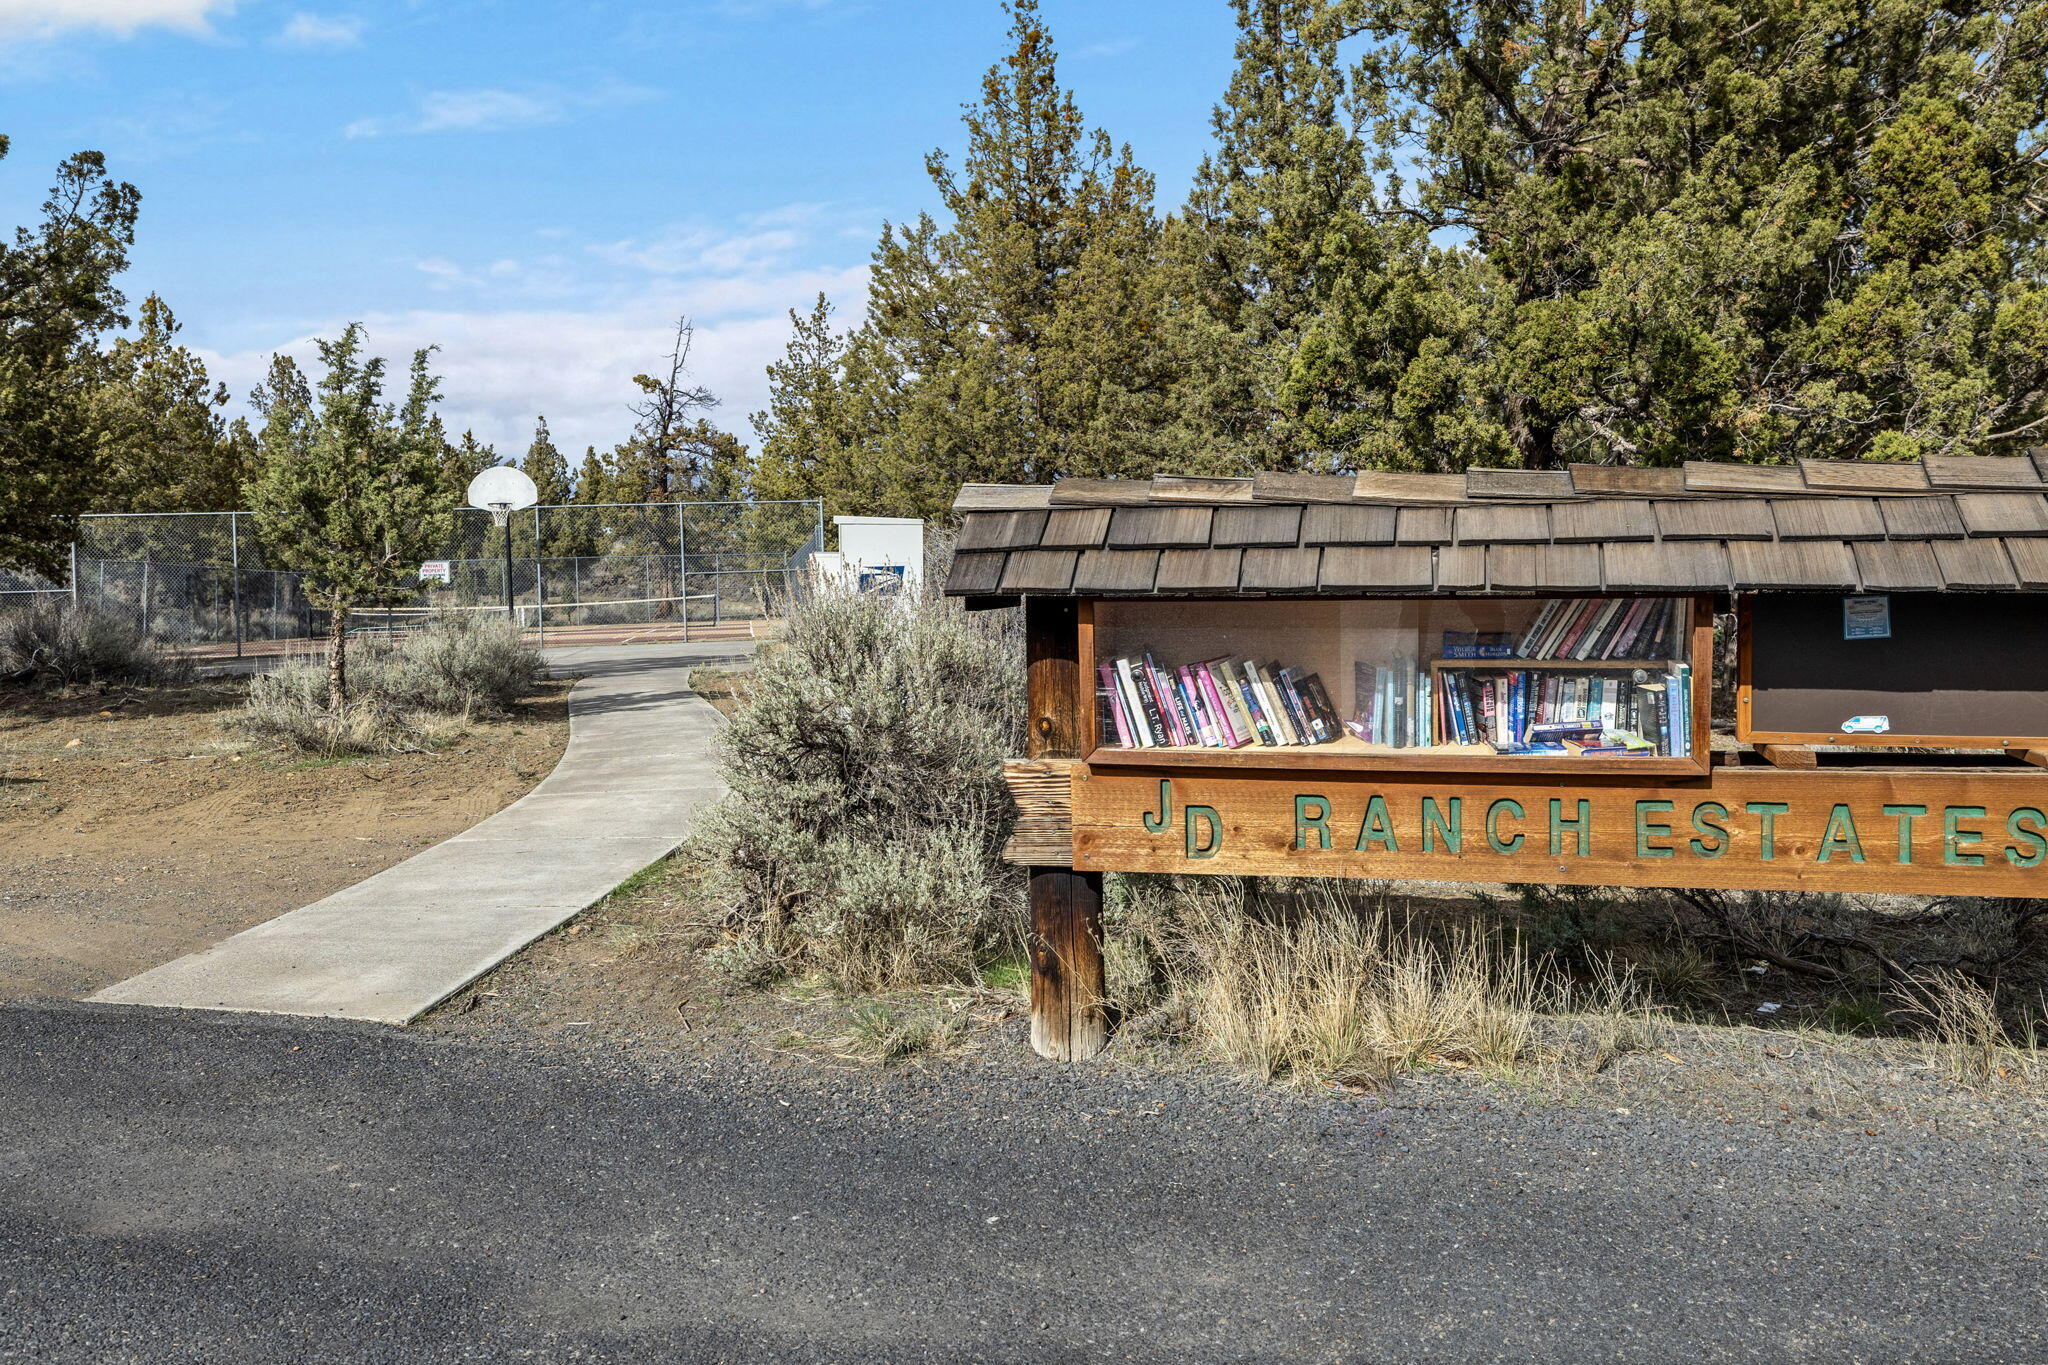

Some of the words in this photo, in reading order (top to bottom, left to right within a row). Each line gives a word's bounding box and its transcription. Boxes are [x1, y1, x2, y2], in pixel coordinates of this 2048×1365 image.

[1148, 708, 1160, 724] L.T.
[1154, 723, 1166, 744] Ryan
[1174, 696, 1184, 711] LIFE
[1181, 716, 1192, 735] MARS
[1143, 778, 1223, 860] JD
[1294, 793, 1590, 857] RANCH
[1635, 799, 2047, 867] ESTATES
